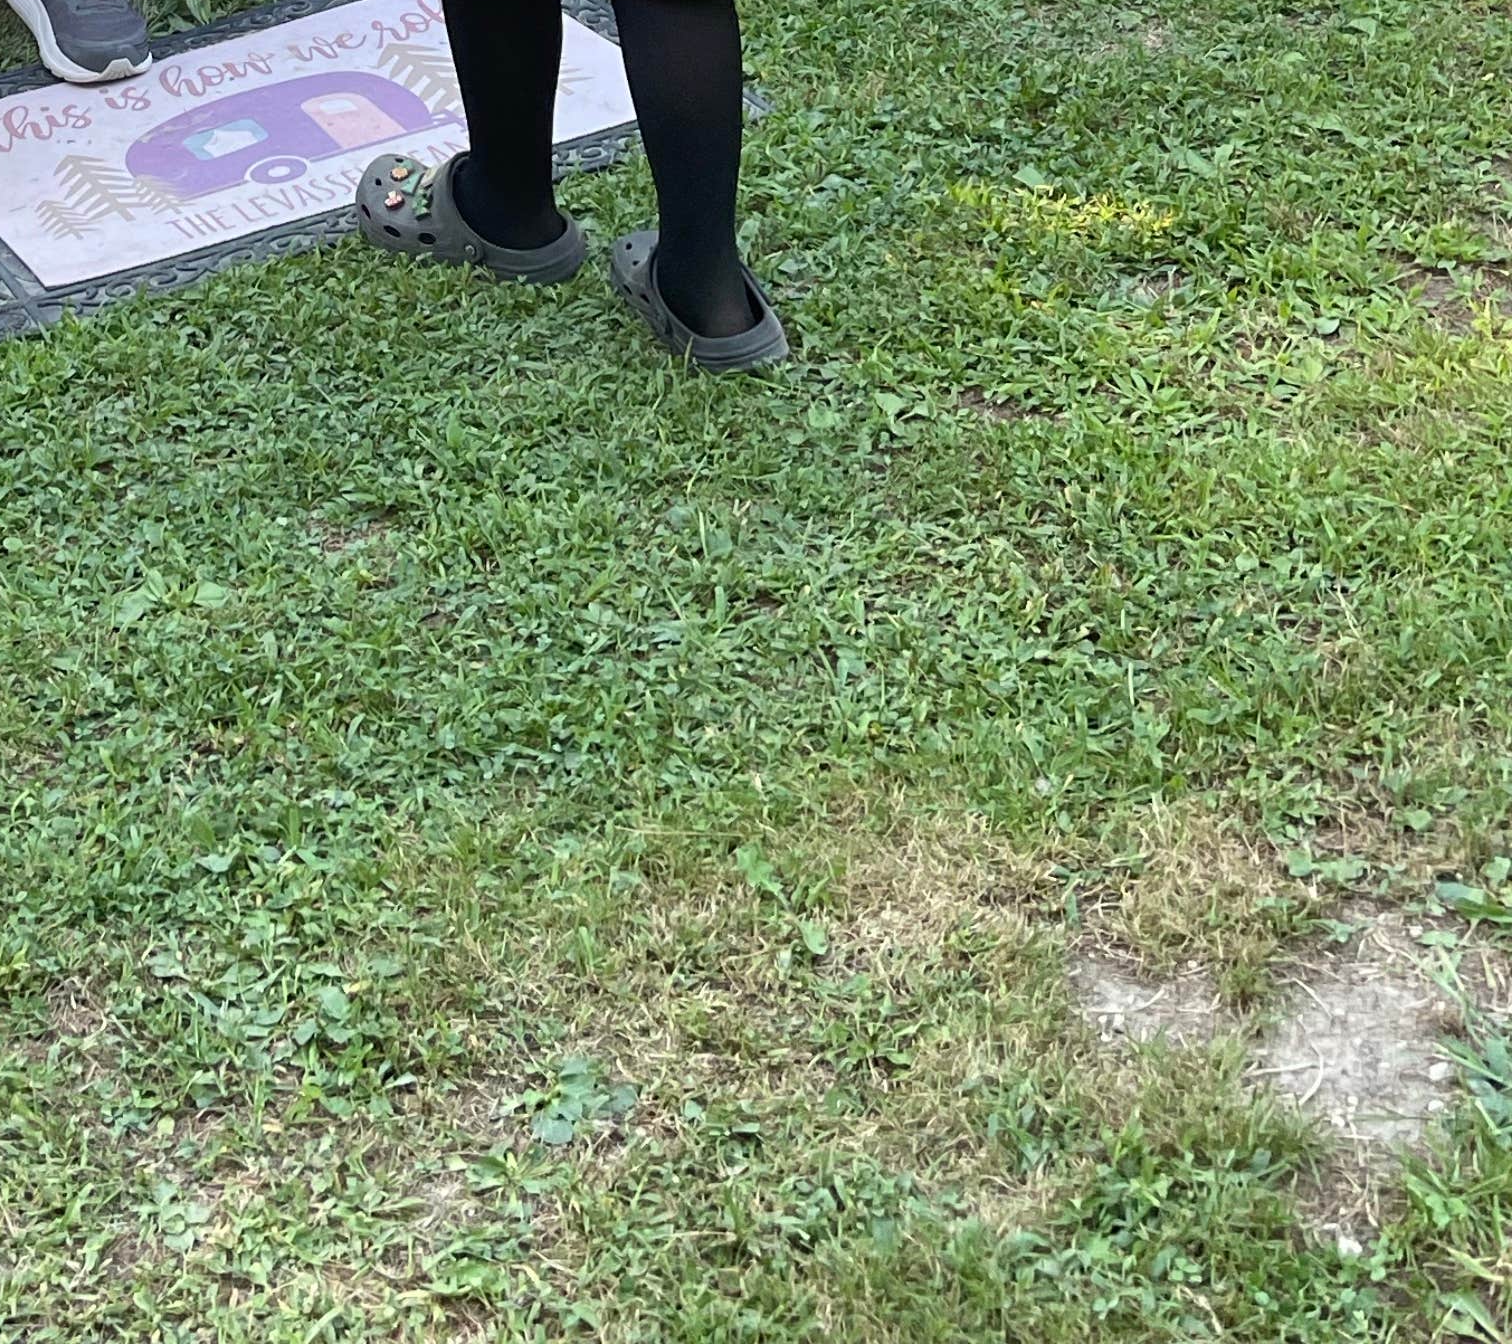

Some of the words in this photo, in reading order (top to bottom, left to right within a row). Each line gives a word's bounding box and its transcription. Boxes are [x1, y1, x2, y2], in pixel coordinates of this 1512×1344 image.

[99, 86, 152, 111] is
[159, 49, 274, 98] how
[288, 29, 368, 64] we
[165, 207, 236, 239] THE
[238, 165, 364, 223] LEVASSE
